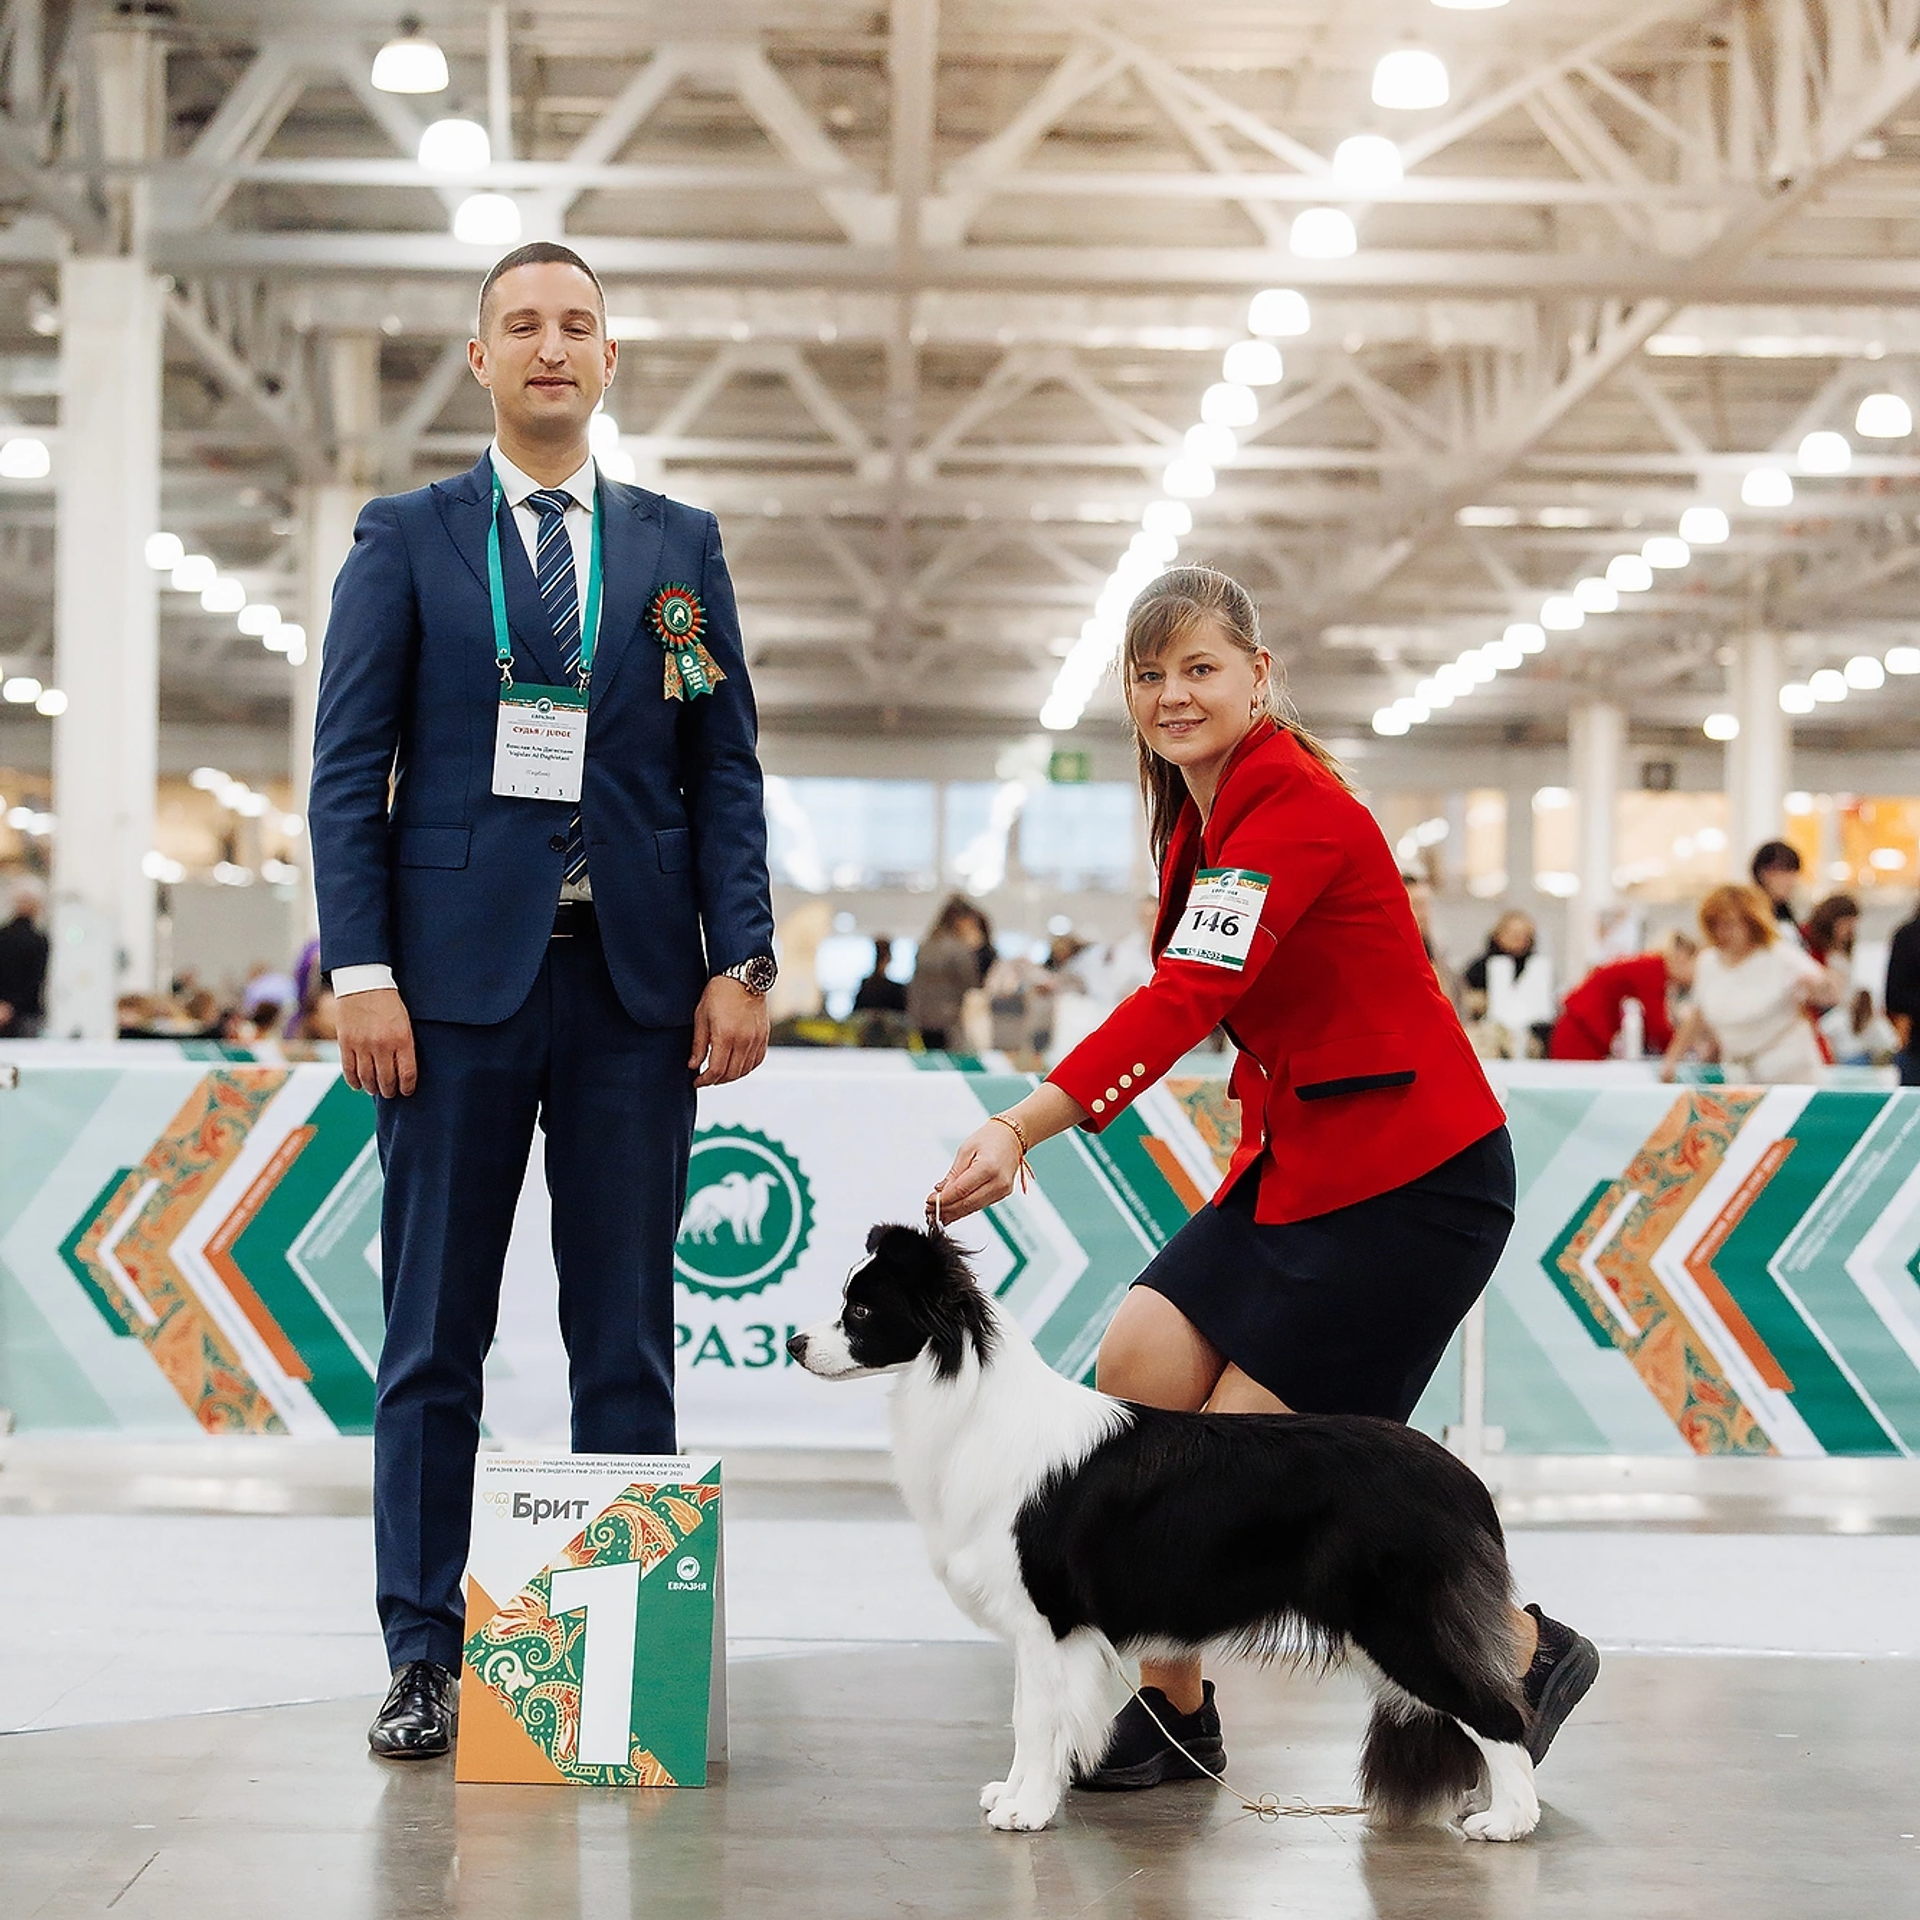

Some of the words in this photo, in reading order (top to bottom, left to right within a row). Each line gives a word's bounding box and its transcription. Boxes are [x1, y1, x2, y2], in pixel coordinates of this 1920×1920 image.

[512, 726, 540, 735] СУДЬЯ
[546, 729, 571, 738] JUDGE
[534, 786, 540, 794] 2
[558, 788, 563, 796] 3
[1191, 910, 1239, 937] 146
[512, 1491, 590, 1525] Брит
[667, 1581, 708, 1591] ЕВРАЗИЯ
[550, 1560, 642, 1765] 1
